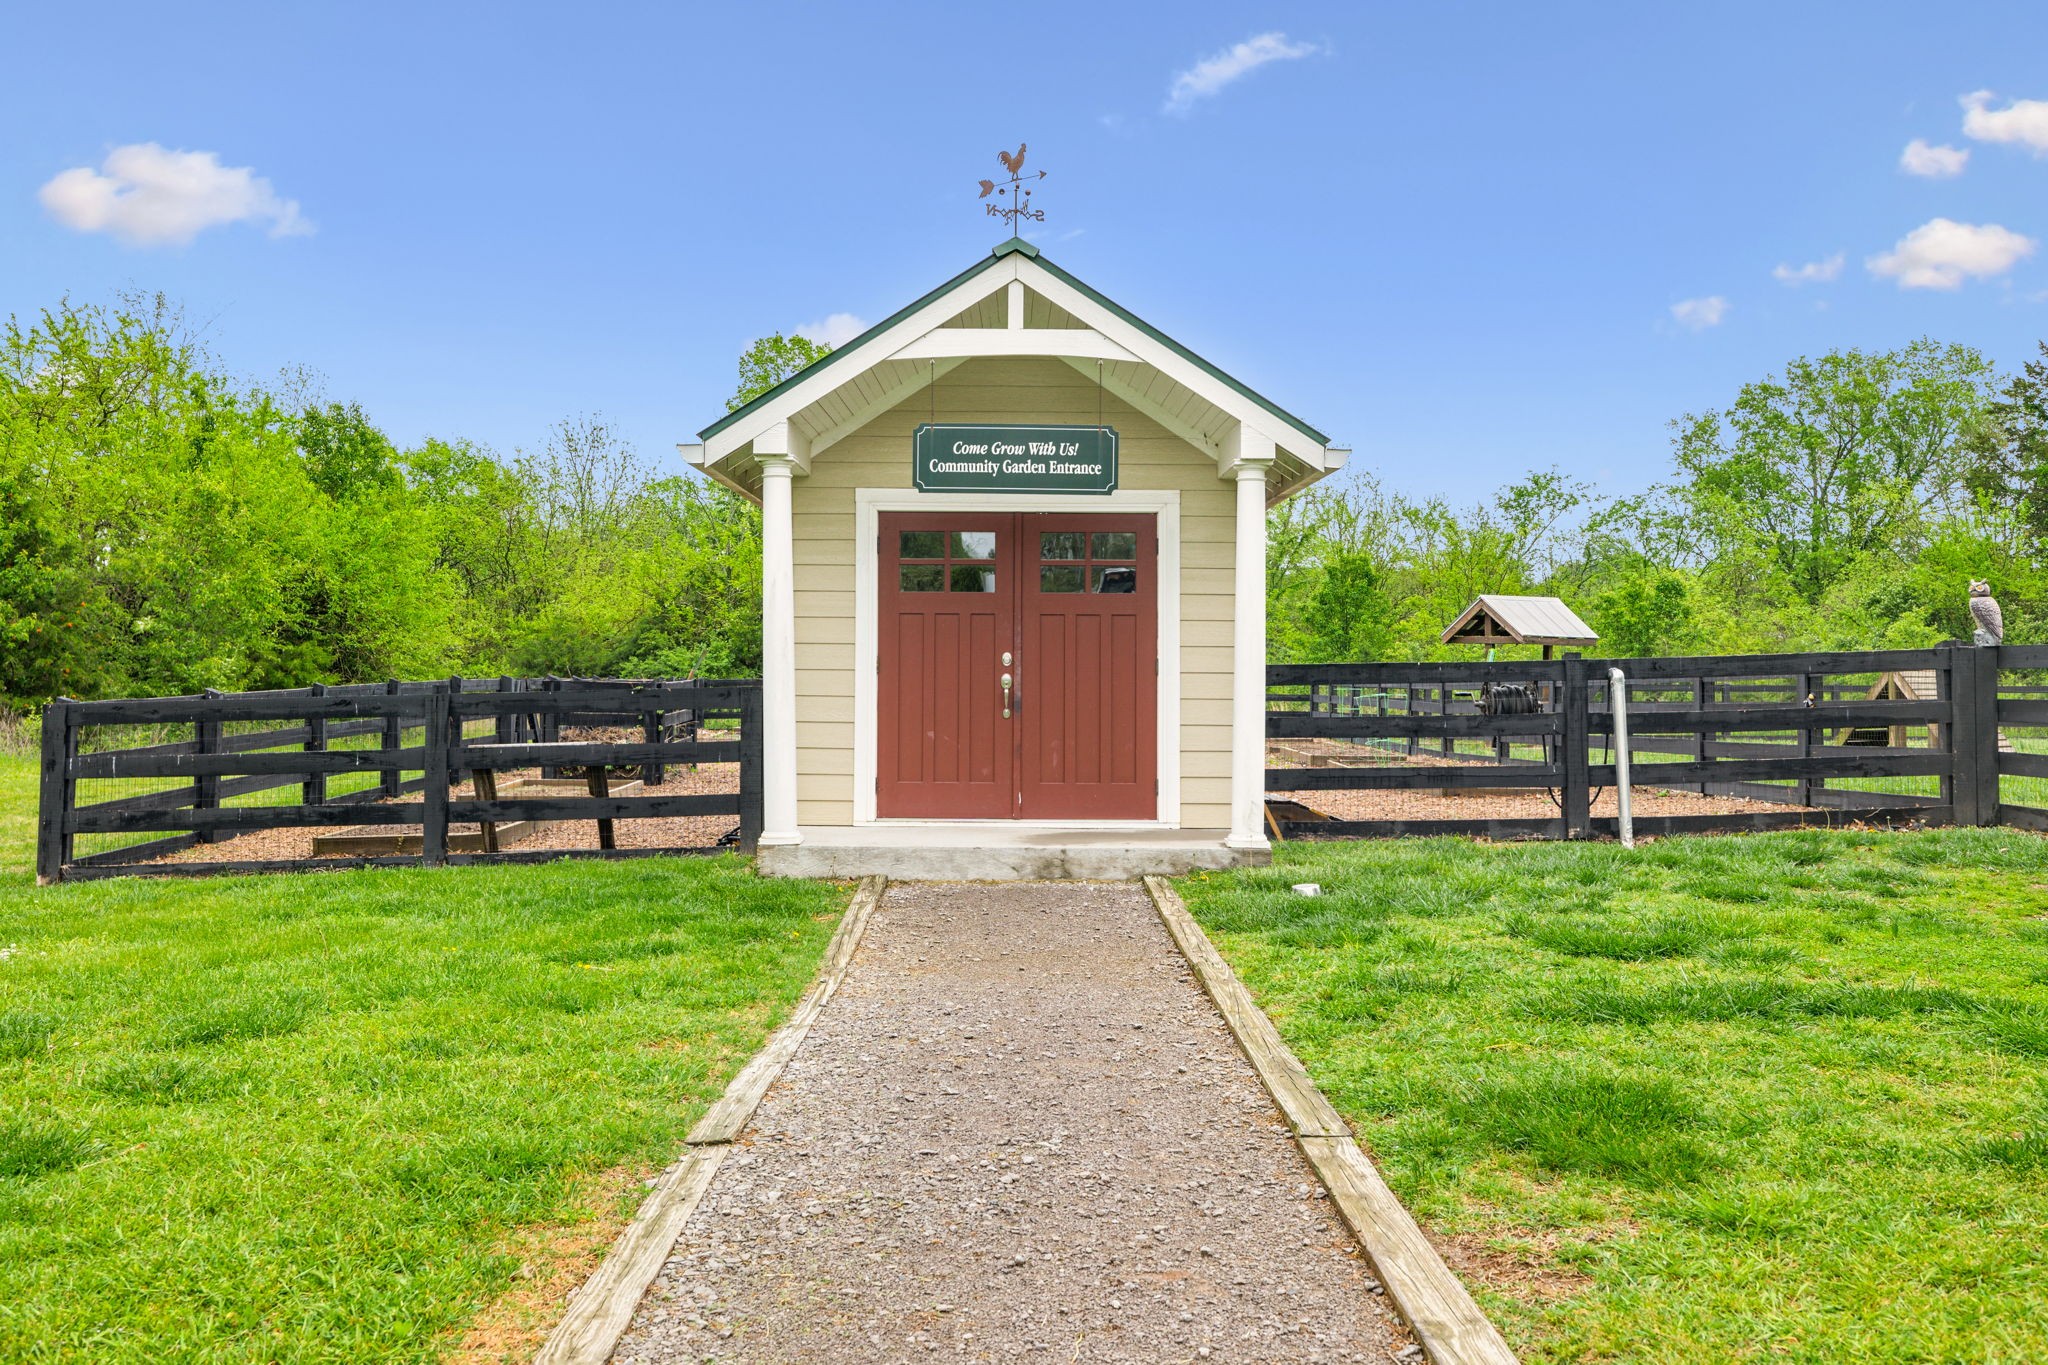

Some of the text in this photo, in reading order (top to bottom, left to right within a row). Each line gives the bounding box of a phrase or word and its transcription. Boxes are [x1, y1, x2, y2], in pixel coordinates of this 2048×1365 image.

[952, 441, 1080, 456] Come Grow With Us!
[929, 458, 1102, 477] Community Garden Entrance
